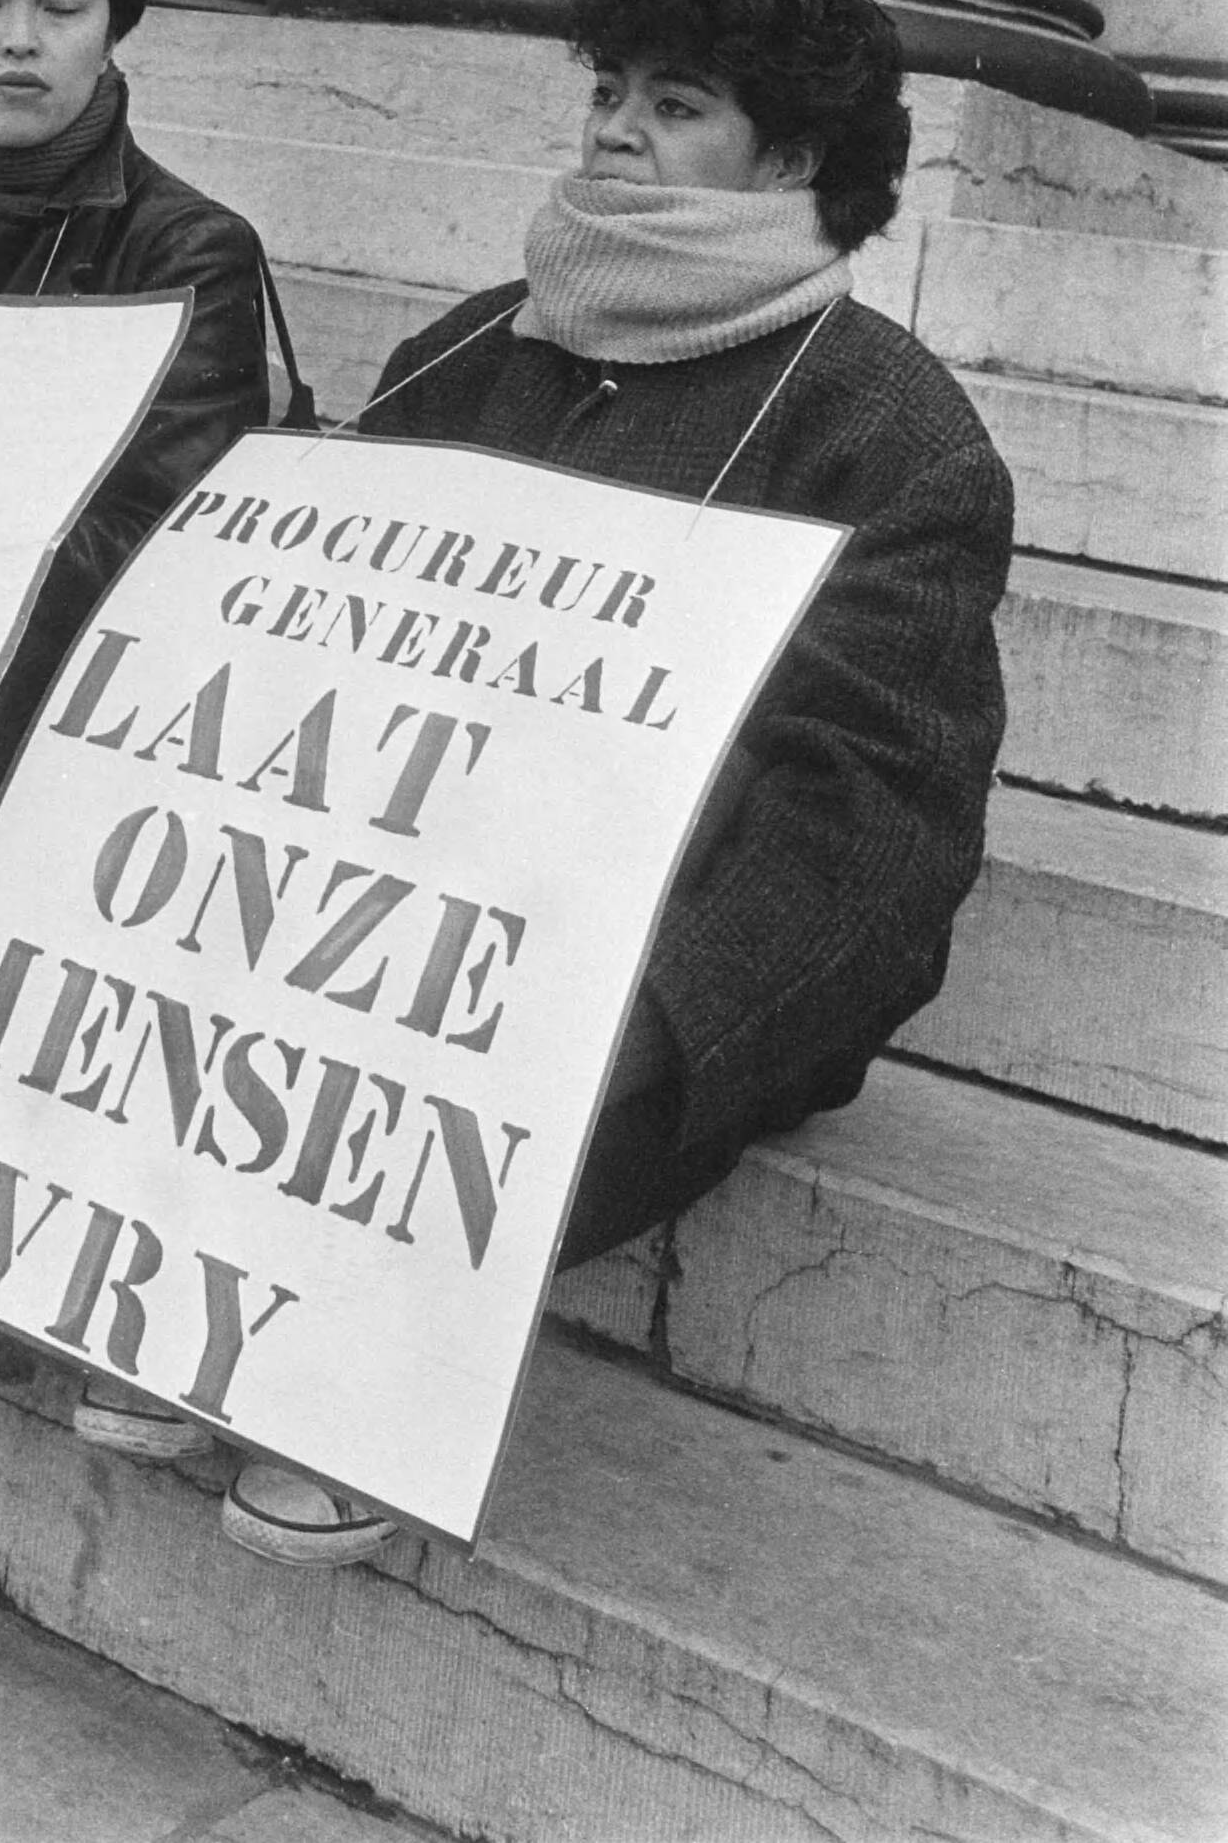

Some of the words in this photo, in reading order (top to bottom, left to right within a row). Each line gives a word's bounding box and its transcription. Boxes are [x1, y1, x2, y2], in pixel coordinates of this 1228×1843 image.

[167, 490, 659, 629] PROCUREUR
[49, 627, 493, 838] LAAT
[220, 573, 678, 731] GENERAAL
[92, 804, 526, 1054] ONZE
